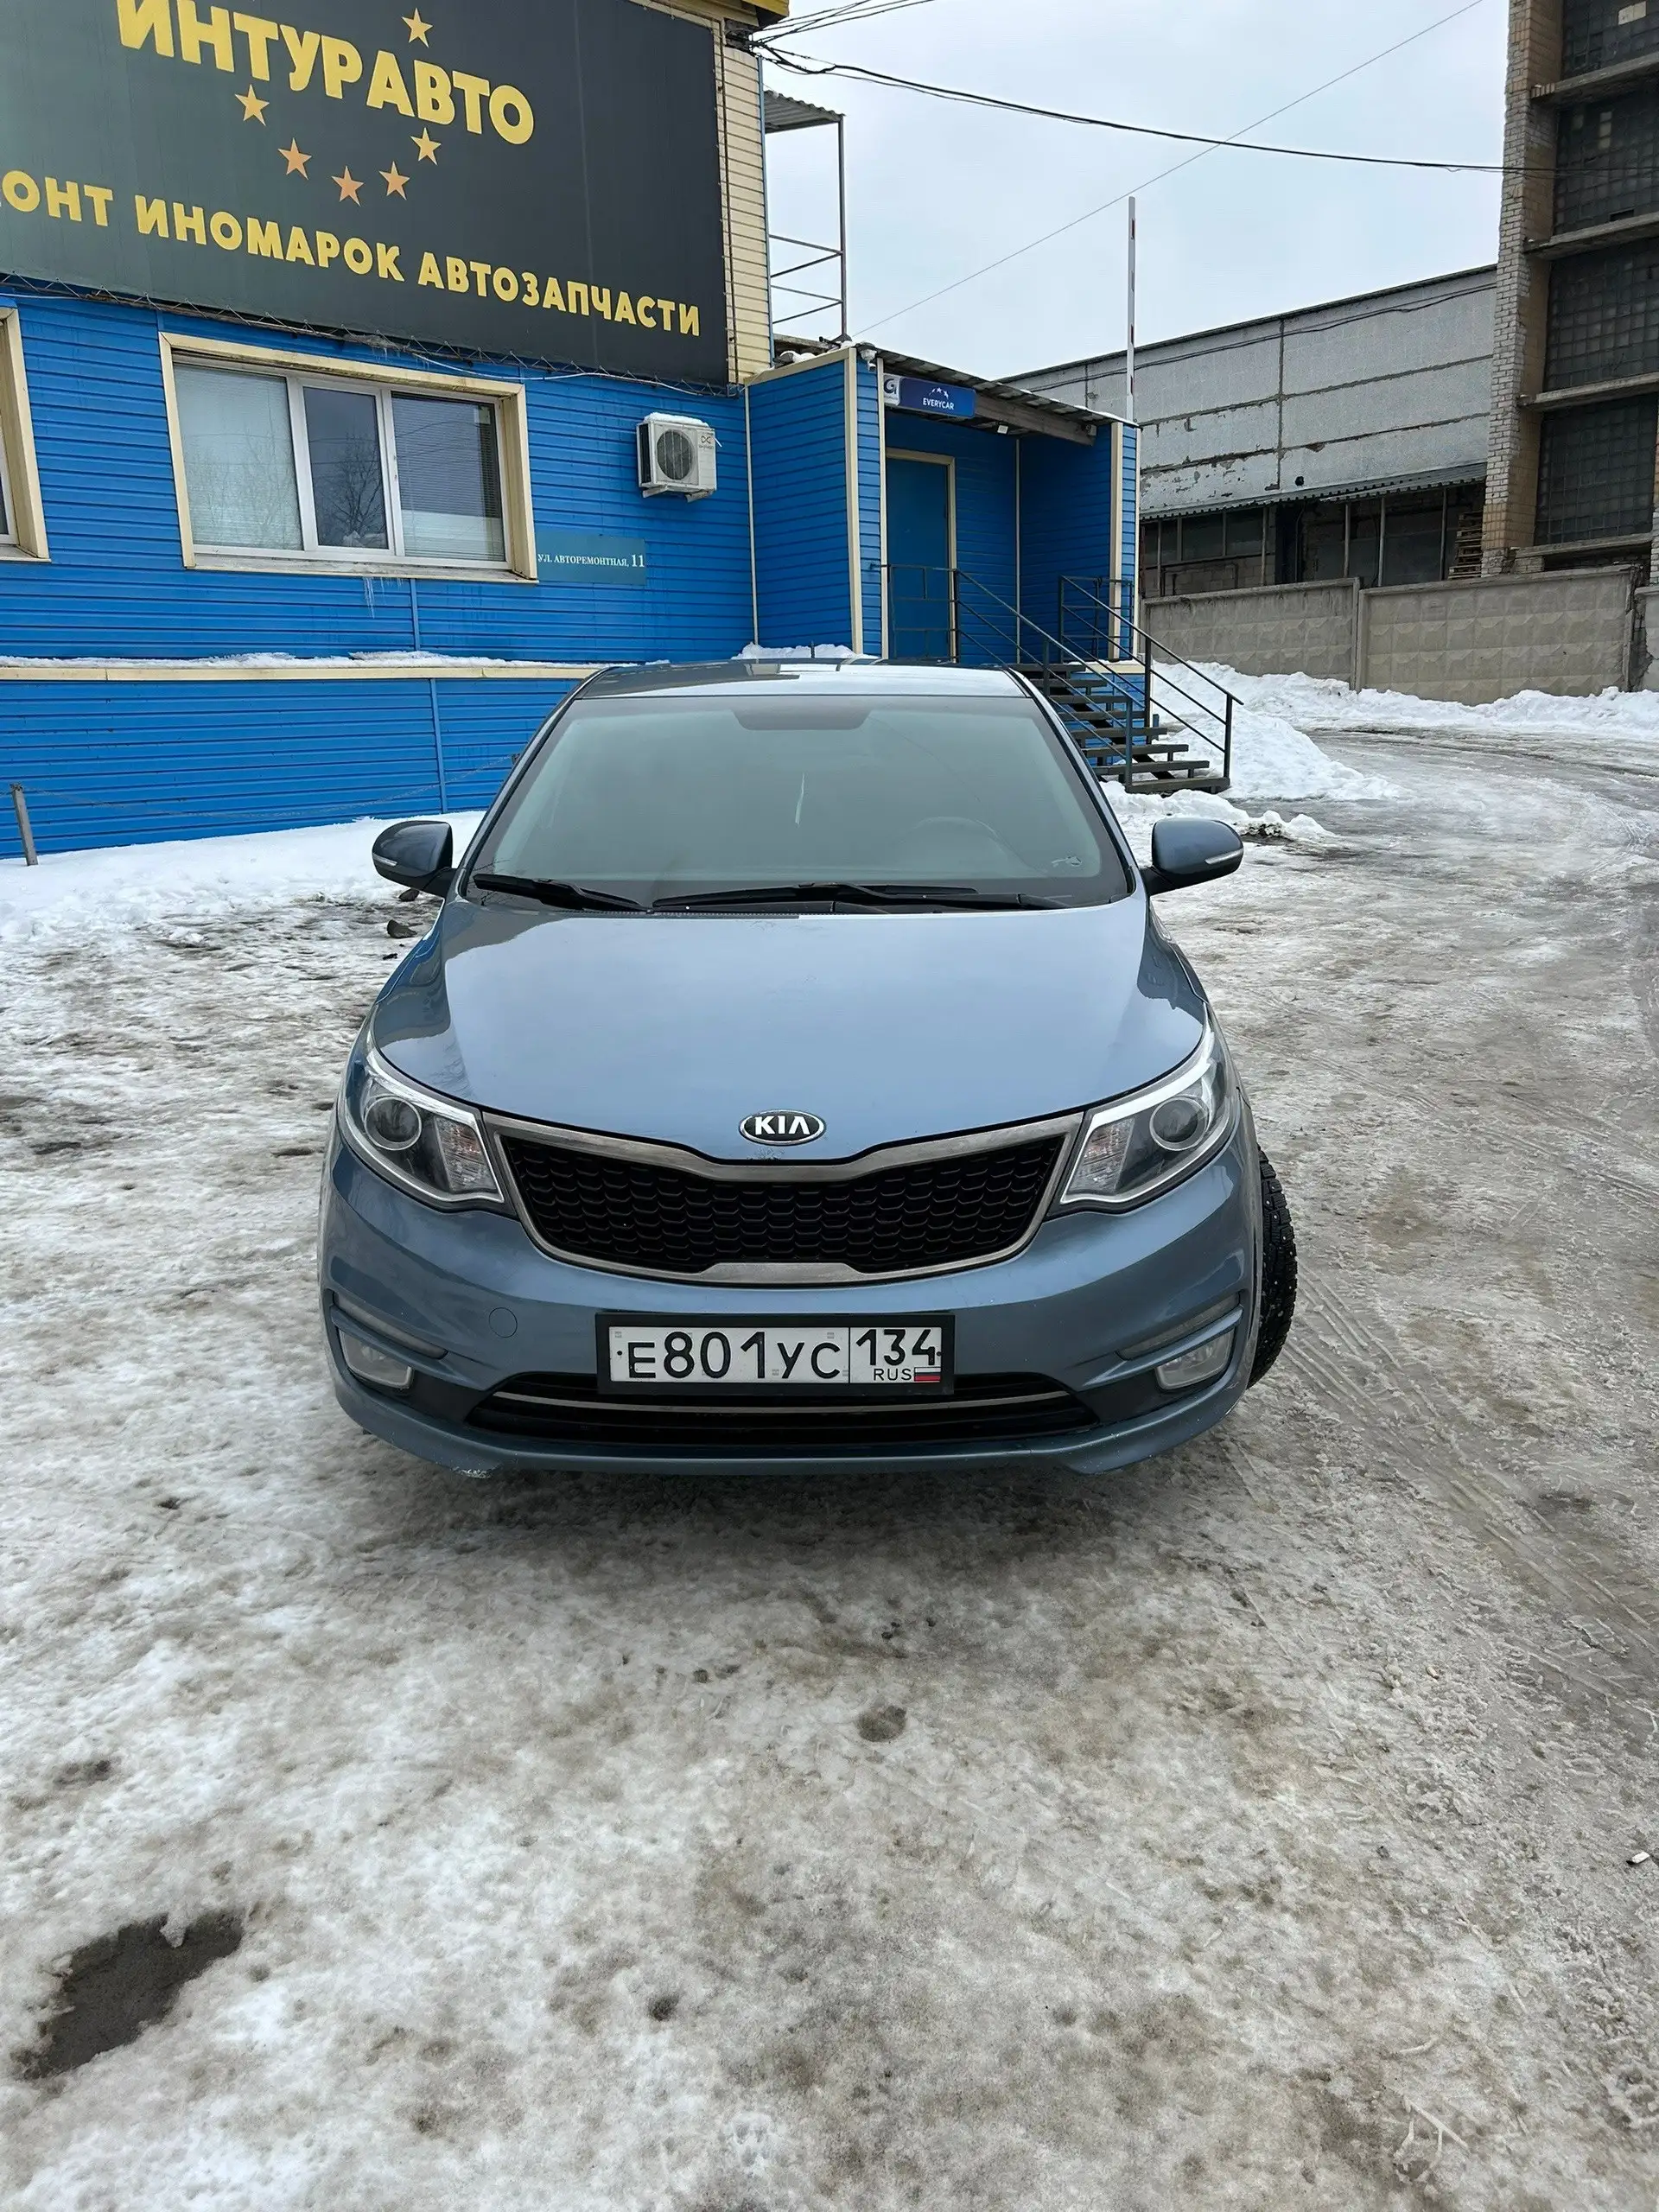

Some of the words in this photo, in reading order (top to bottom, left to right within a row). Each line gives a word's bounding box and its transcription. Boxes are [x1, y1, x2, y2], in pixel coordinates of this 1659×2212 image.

[117, 0, 534, 144] ИНТУРАВТО
[0, 170, 114, 227] ОНТ
[135, 194, 405, 282] ИНОМАРОК
[418, 251, 700, 336] АВТОЗАПЧАСТИ
[922, 397, 955, 410] EVERYCAR
[537, 553, 553, 563] УЛ.
[554, 555, 630, 568] АВТОРЕМОНТНАЯ,
[631, 554, 645, 568] 11
[753, 1115, 811, 1136] KIA
[855, 1328, 936, 1366] 134
[873, 1368, 912, 1381] RUS
